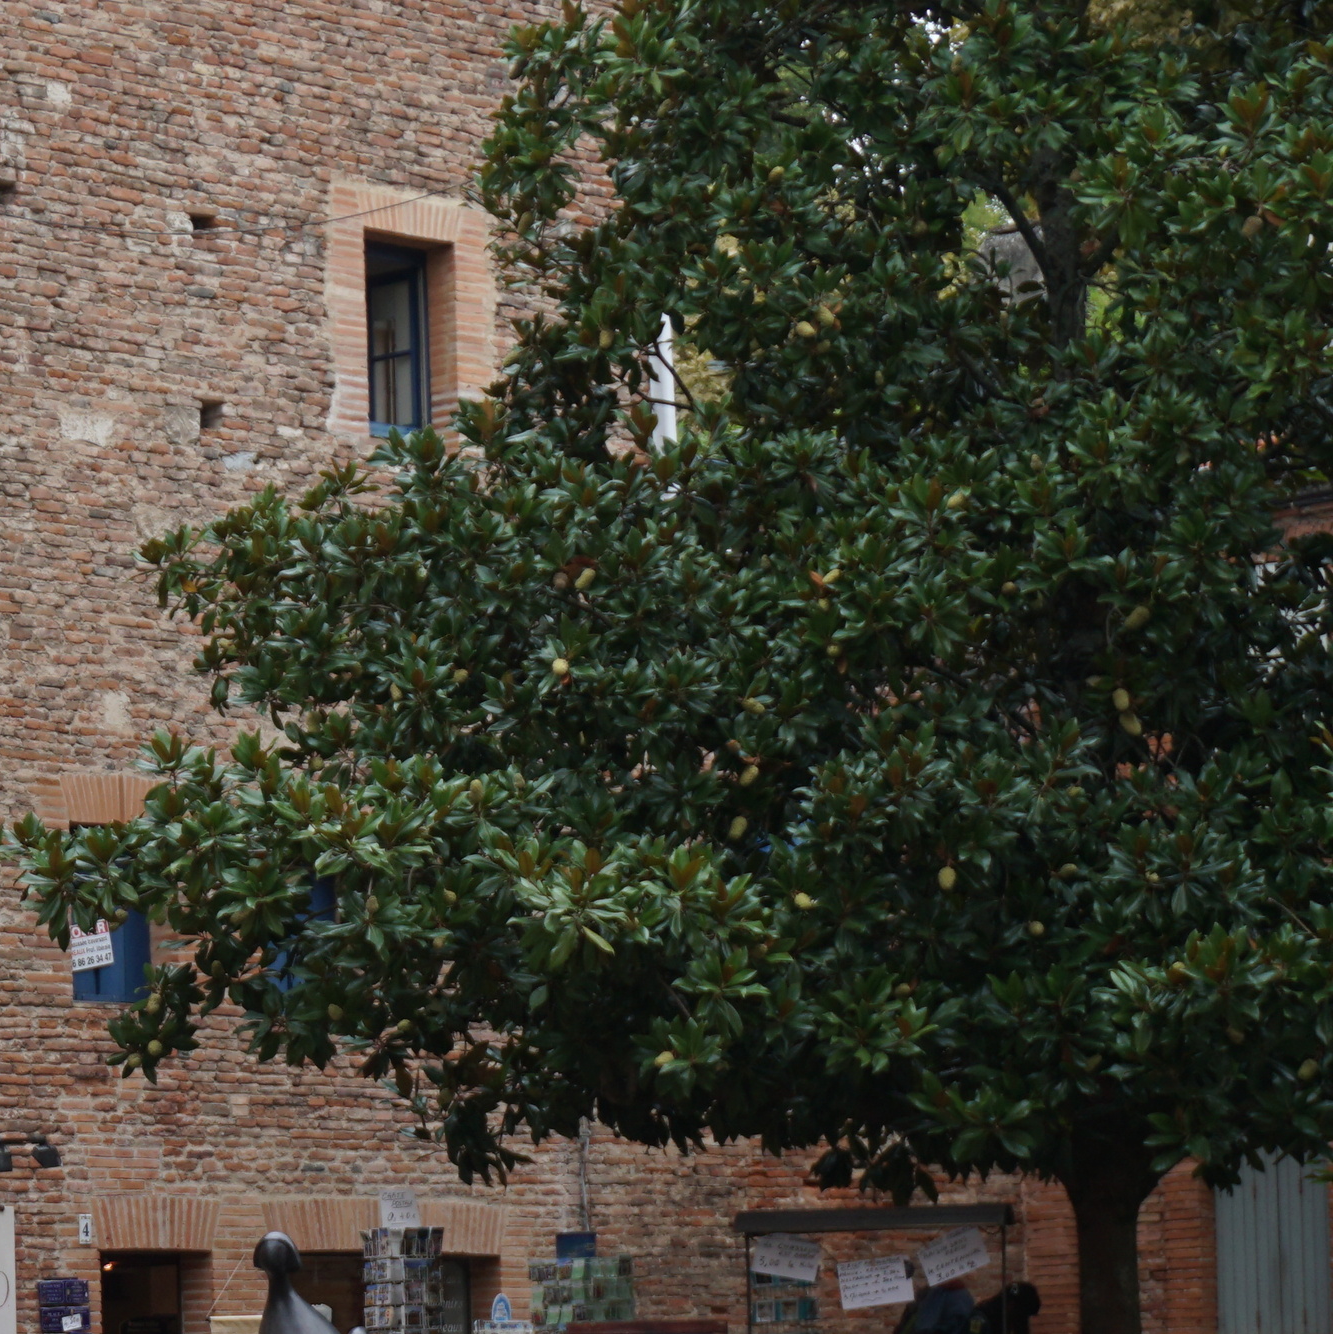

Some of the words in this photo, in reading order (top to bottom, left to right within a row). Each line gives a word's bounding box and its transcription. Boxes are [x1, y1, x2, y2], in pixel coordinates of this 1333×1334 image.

[78, 958, 86, 967] 86
[87, 956, 95, 965] 26
[96, 954, 104, 963] 34
[105, 952, 112, 961] 47
[82, 1222, 90, 1237] 4
